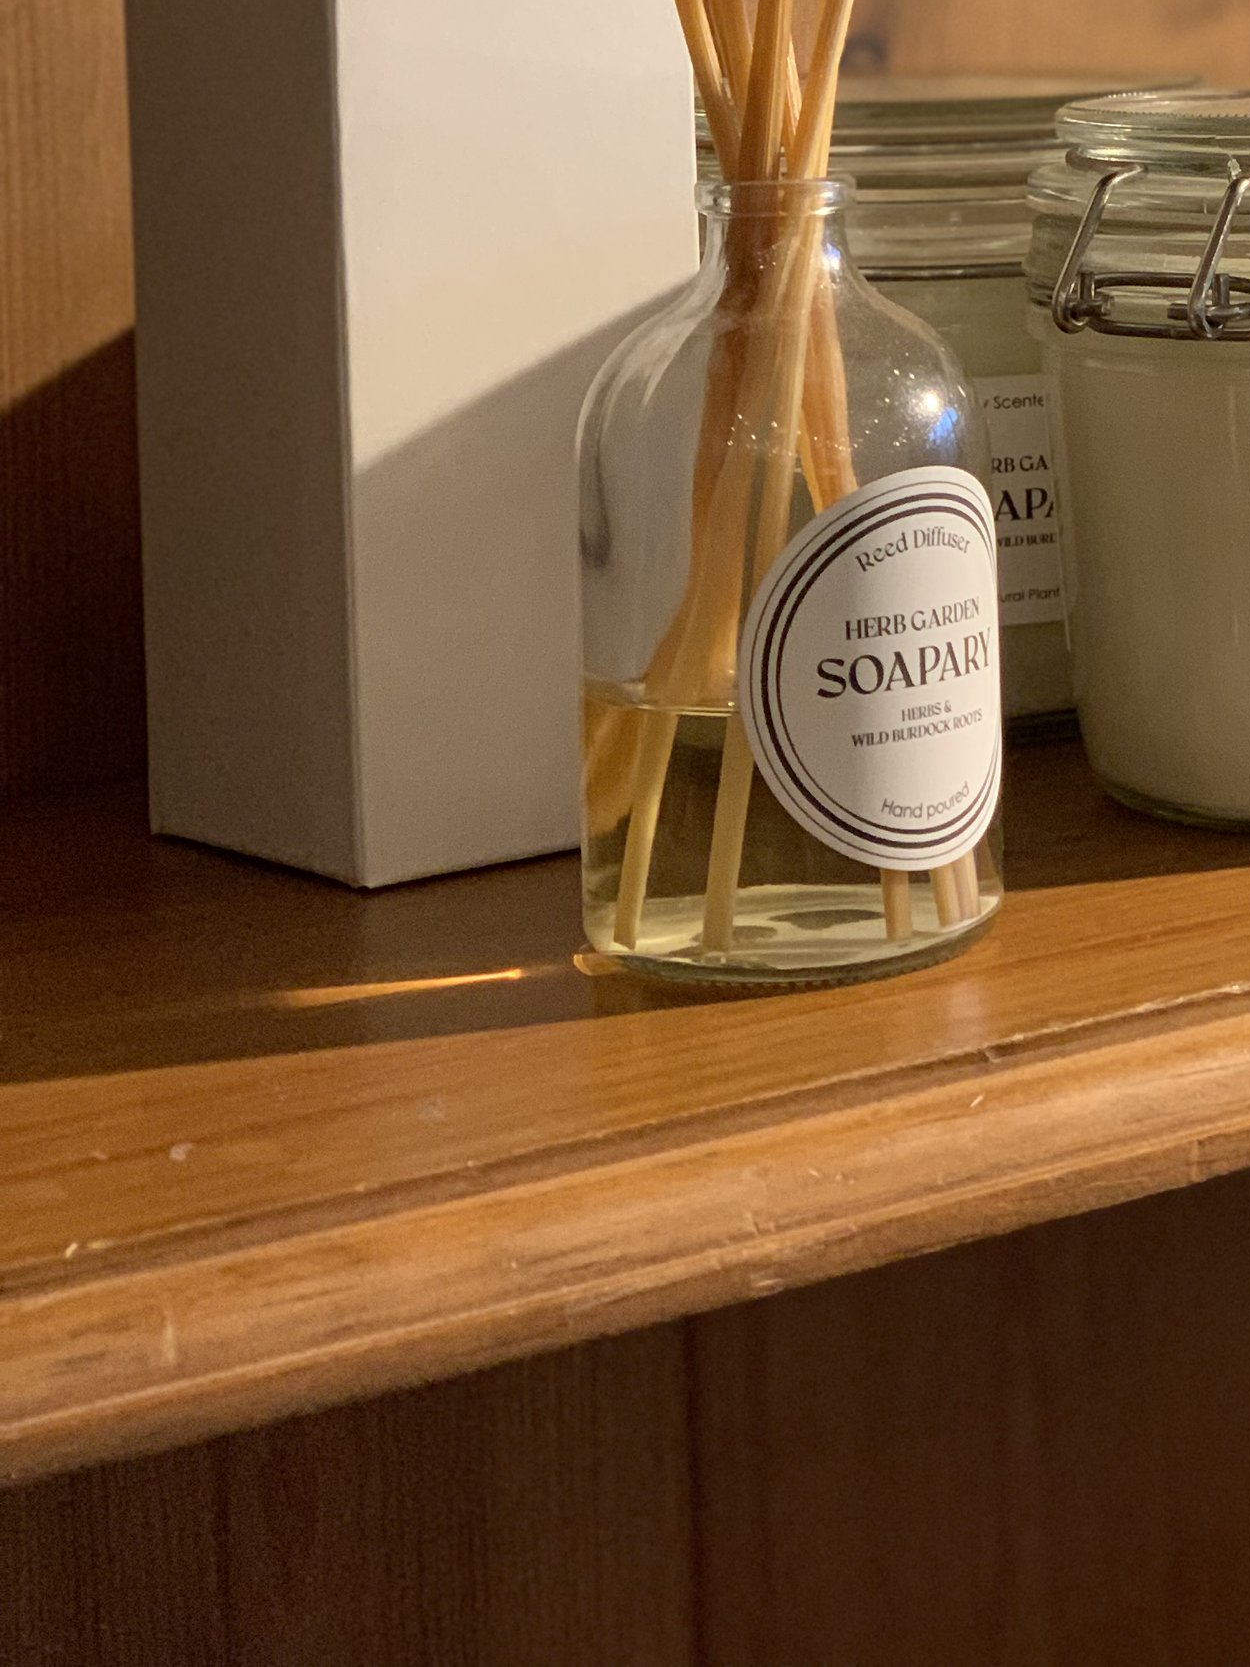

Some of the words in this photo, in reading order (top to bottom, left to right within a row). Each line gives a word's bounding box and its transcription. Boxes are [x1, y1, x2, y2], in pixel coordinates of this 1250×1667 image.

[993, 393, 1044, 410] Scente
[991, 456, 1016, 473] RB
[855, 532, 909, 572] Reed
[913, 526, 970, 554] Diffuser
[845, 613, 907, 640] HERB
[910, 596, 980, 631] GARDEN
[816, 627, 991, 698] SOAPARY
[851, 731, 889, 748] WILD
[892, 719, 951, 743] BURDOCK
[953, 708, 983, 730] ROOTS
[901, 702, 942, 722] HERBS
[943, 699, 952, 714] &
[881, 797, 923, 818] Hand
[926, 781, 970, 821] poured
